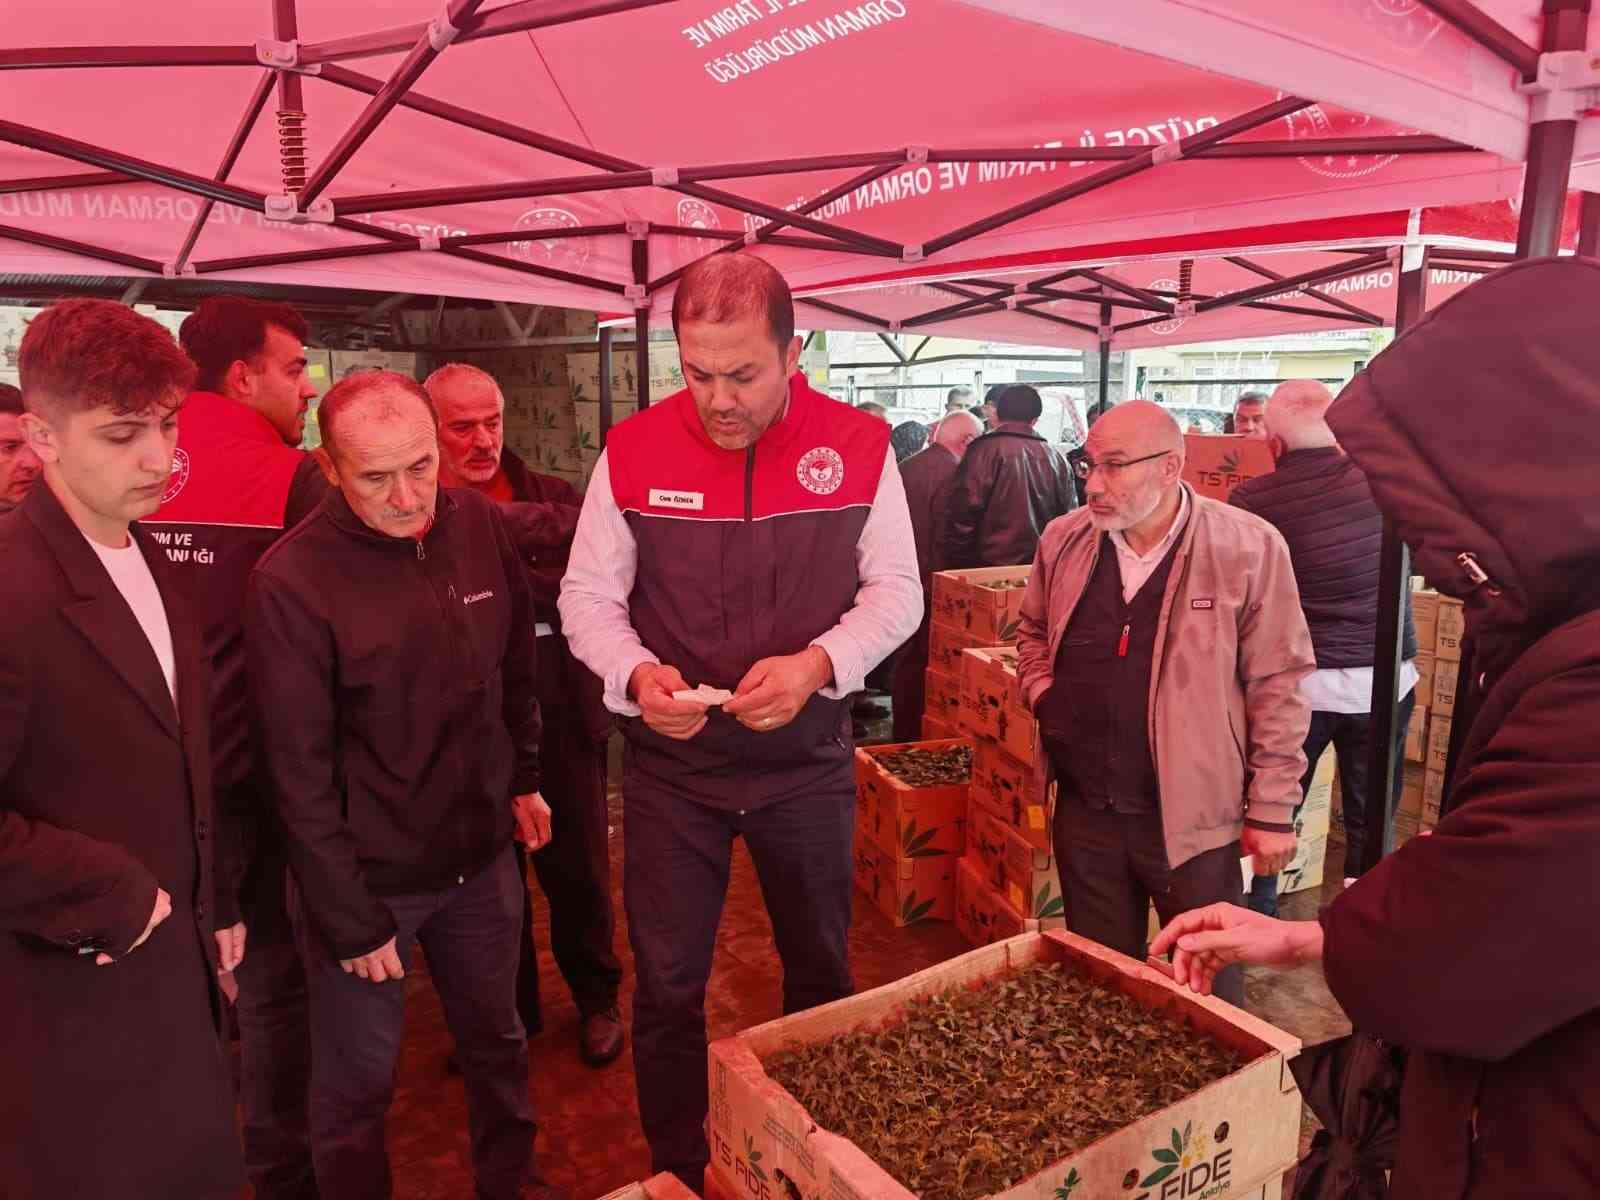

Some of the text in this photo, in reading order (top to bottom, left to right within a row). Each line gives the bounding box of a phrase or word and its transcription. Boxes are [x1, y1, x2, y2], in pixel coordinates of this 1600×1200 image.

[1196, 471, 1220, 487] TS
[174, 533, 193, 546] VE
[713, 1130, 731, 1167] TS
[1161, 1148, 1232, 1200] FIDE
